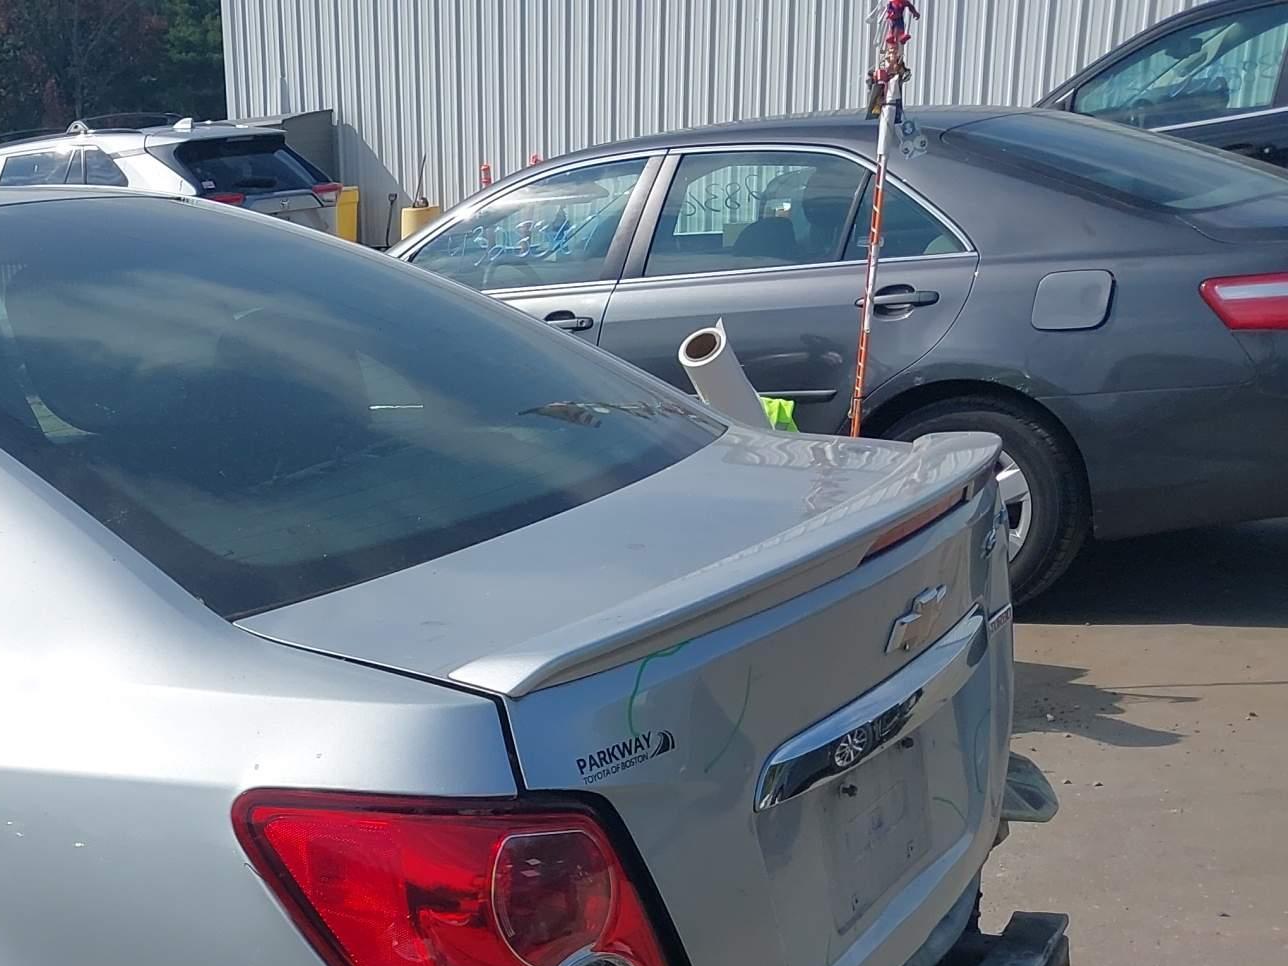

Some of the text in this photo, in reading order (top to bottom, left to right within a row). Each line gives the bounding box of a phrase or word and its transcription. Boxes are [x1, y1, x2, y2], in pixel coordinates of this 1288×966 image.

[576, 731, 651, 775] PARKWAY
[583, 752, 649, 785] TOYOTA OF BOSTON
